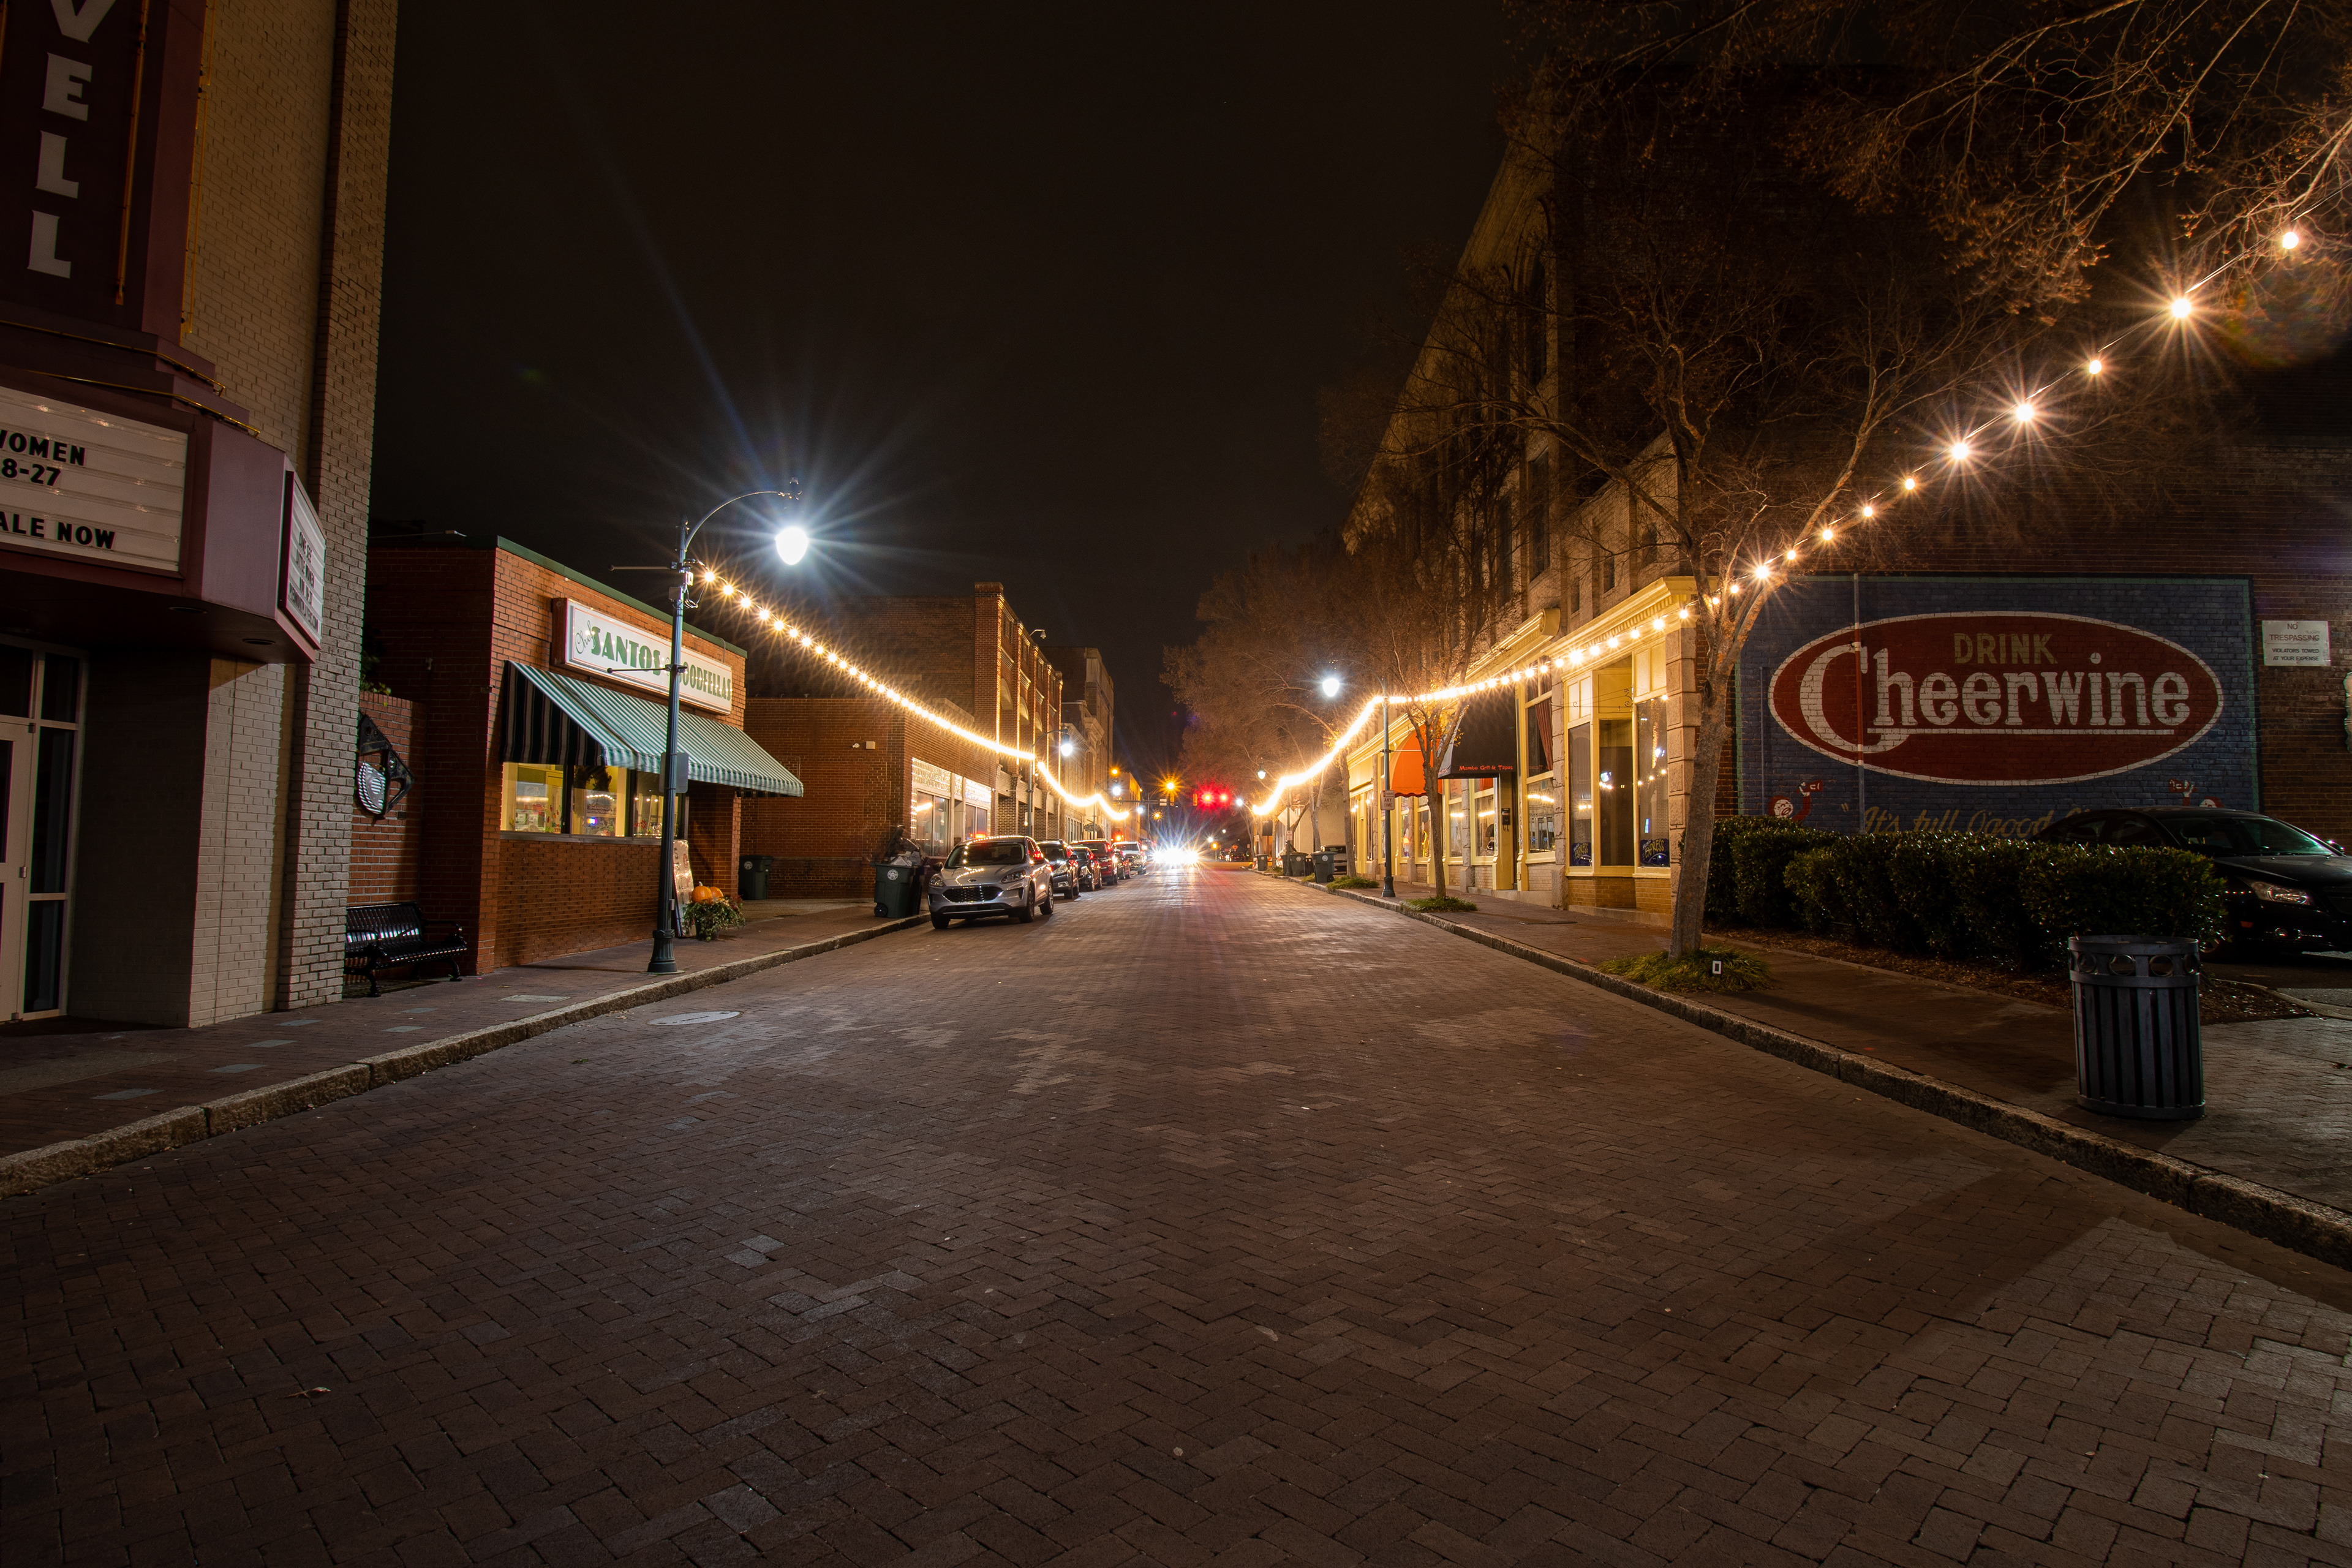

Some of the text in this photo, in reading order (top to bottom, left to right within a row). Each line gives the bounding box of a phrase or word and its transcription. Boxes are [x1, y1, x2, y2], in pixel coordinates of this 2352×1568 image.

[57, 522, 115, 549] NOW
[576, 620, 595, 654] Chef
[591, 626, 662, 676] SANTOS
[677, 662, 731, 701] OODFELLAS
[1954, 632, 2058, 665] DRINK
[1800, 641, 2191, 754] Cheerwine
